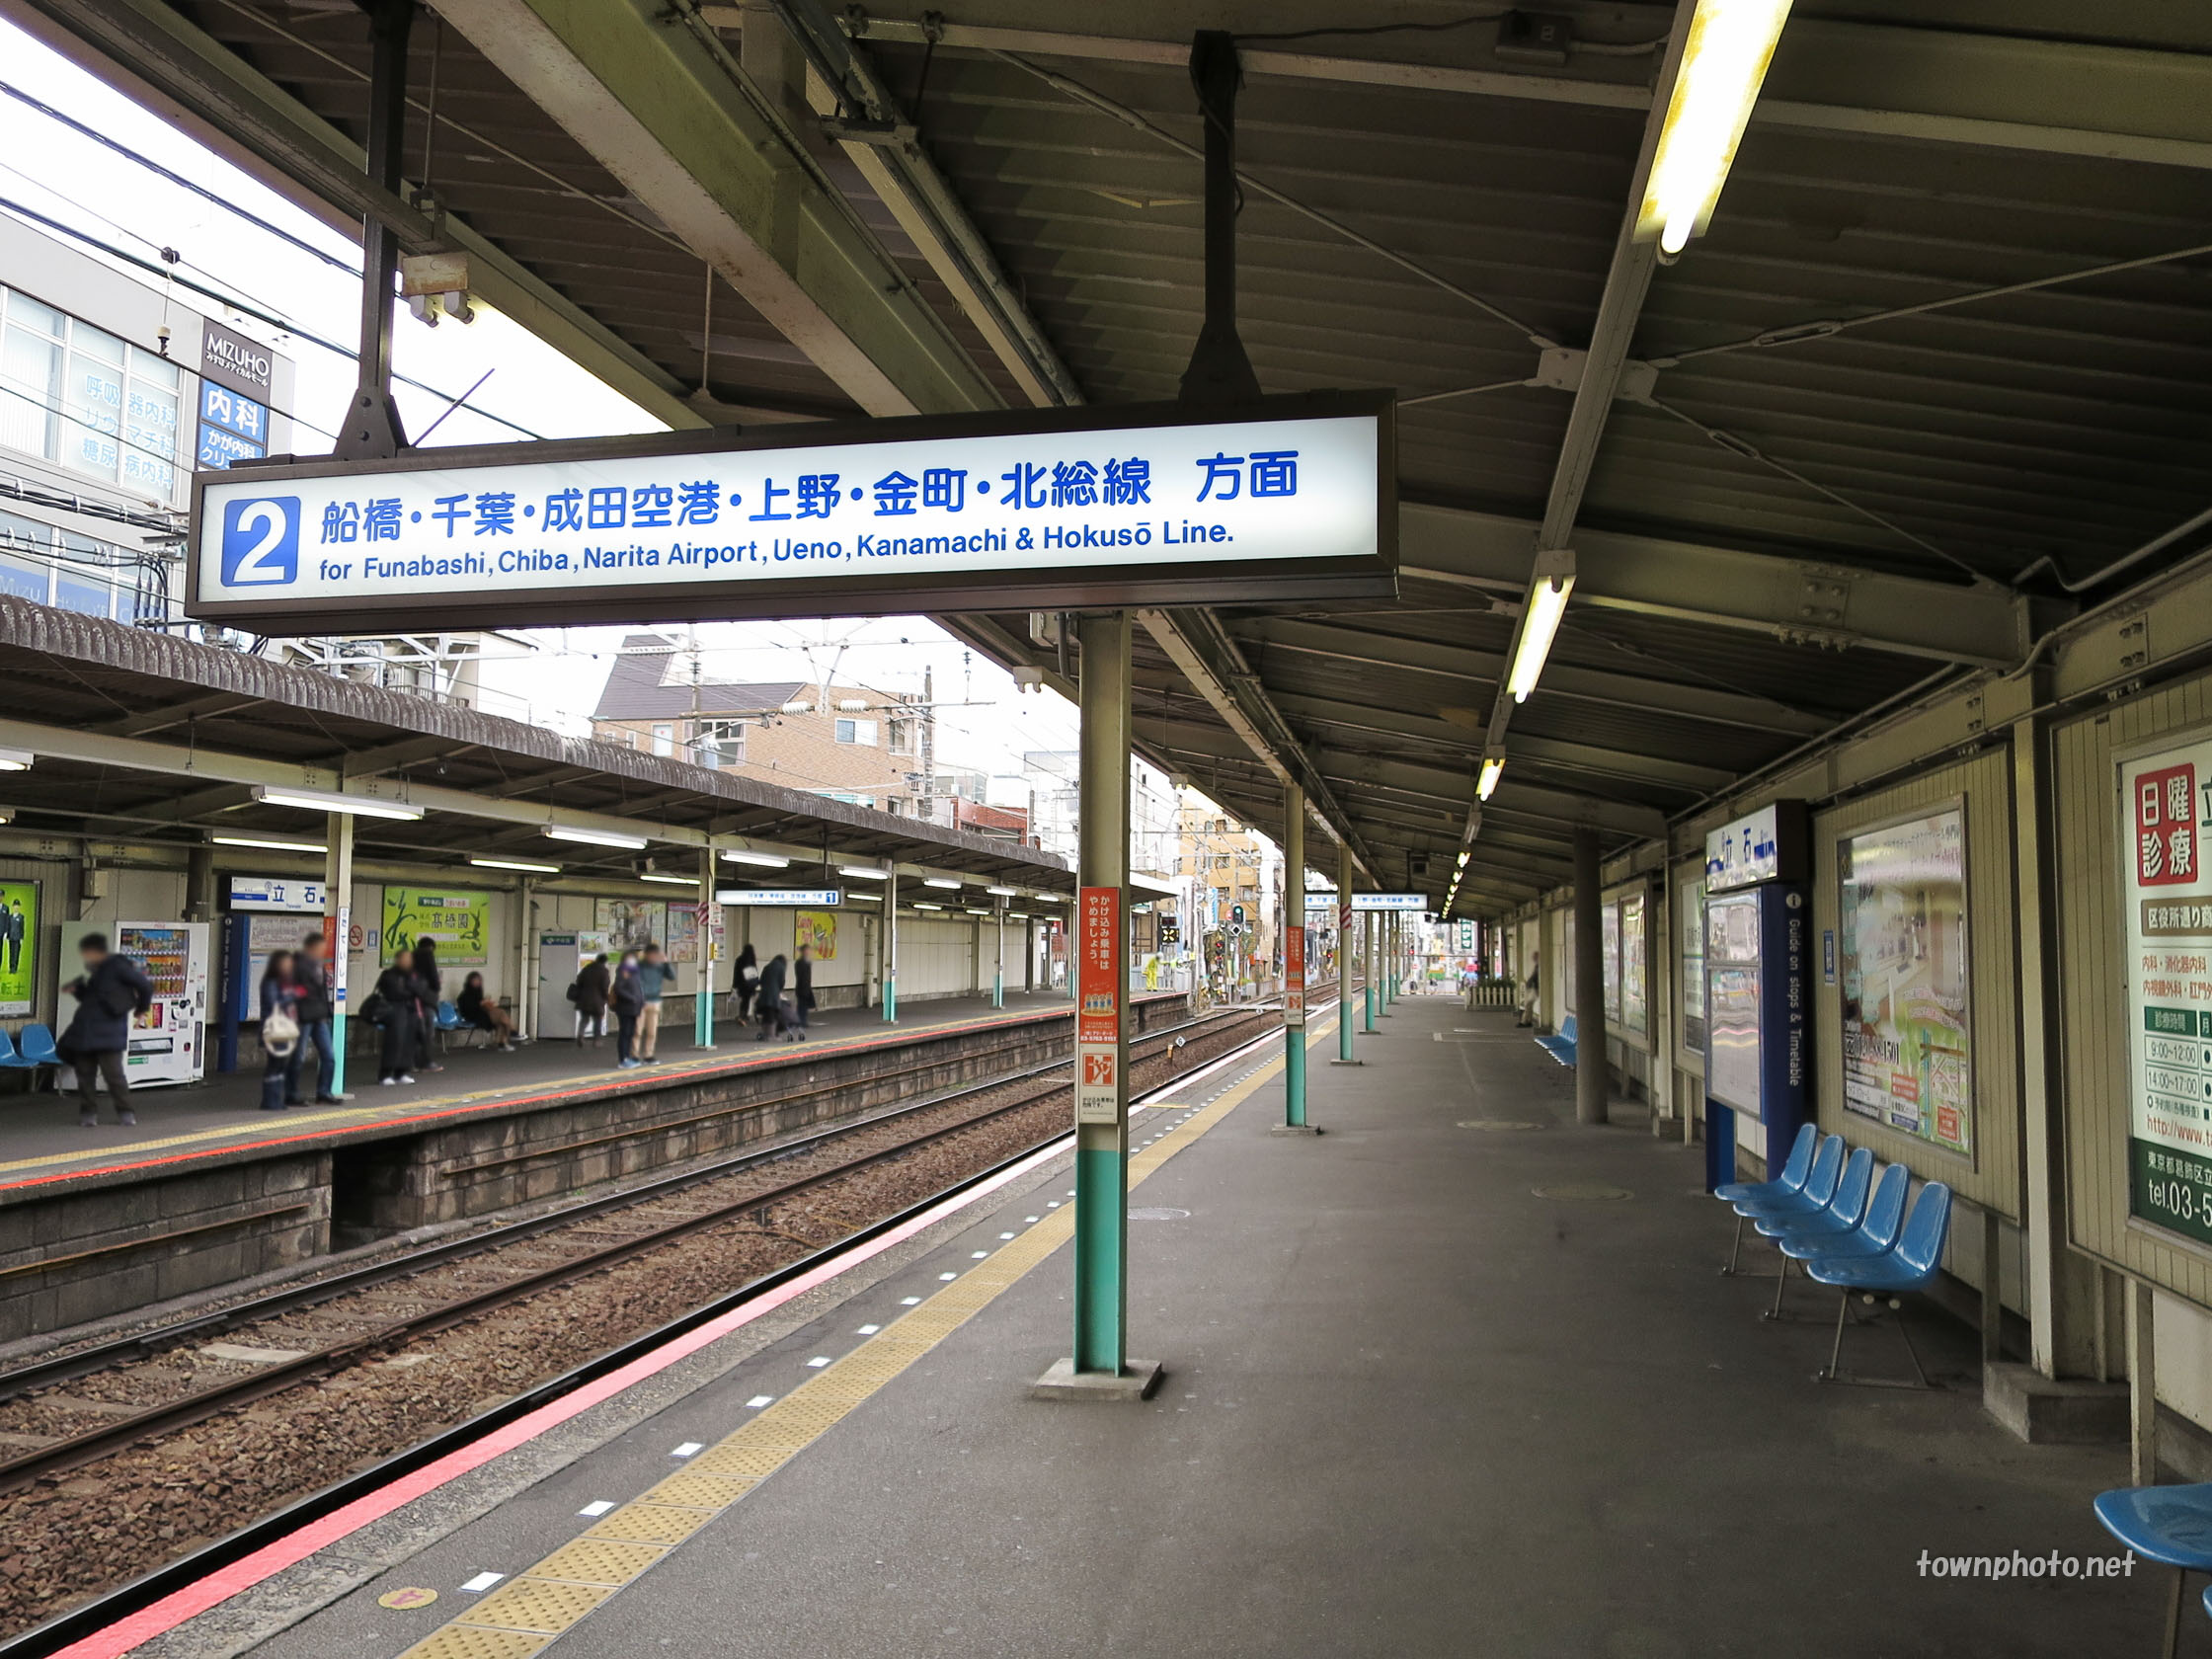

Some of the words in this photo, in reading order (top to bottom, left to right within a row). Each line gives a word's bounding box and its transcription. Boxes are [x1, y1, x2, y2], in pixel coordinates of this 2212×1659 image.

[205, 352, 269, 387] みずほメディカルモール
[206, 333, 269, 376] MIZUHO
[86, 375, 176, 432] 呼吸器内科
[207, 389, 260, 435] 内科
[85, 406, 175, 460] リウマチ科
[207, 430, 256, 459] かが内科
[82, 437, 174, 490] 糖尿病内科
[1196, 449, 1299, 503] 方面
[234, 501, 286, 583] 2
[321, 560, 353, 580] for
[364, 551, 494, 578] Funabashi,
[498, 546, 579, 576] Chiba,
[584, 544, 660, 569] Narita
[668, 539, 768, 569] Airport,
[773, 539, 852, 563] Ueno,
[857, 533, 1006, 557] Kanamachi
[1016, 527, 1034, 551] &
[1044, 522, 1151, 549] Hokusō
[1164, 521, 1234, 544] Line.
[2141, 774, 2191, 828] 日曜
[2141, 827, 2192, 878] 診療
[1088, 895, 1099, 965] やめましょう。
[1099, 895, 1111, 971] かけ込み乗車は
[1789, 918, 1801, 952] Guide
[1789, 956, 1800, 971] on
[1788, 976, 1800, 1009] stops
[1789, 1011, 1801, 1023] &
[1177, 1037, 1184, 1046] 6
[2154, 1010, 2186, 1033] 診療時間
[1788, 1028, 1802, 1087] Timetable
